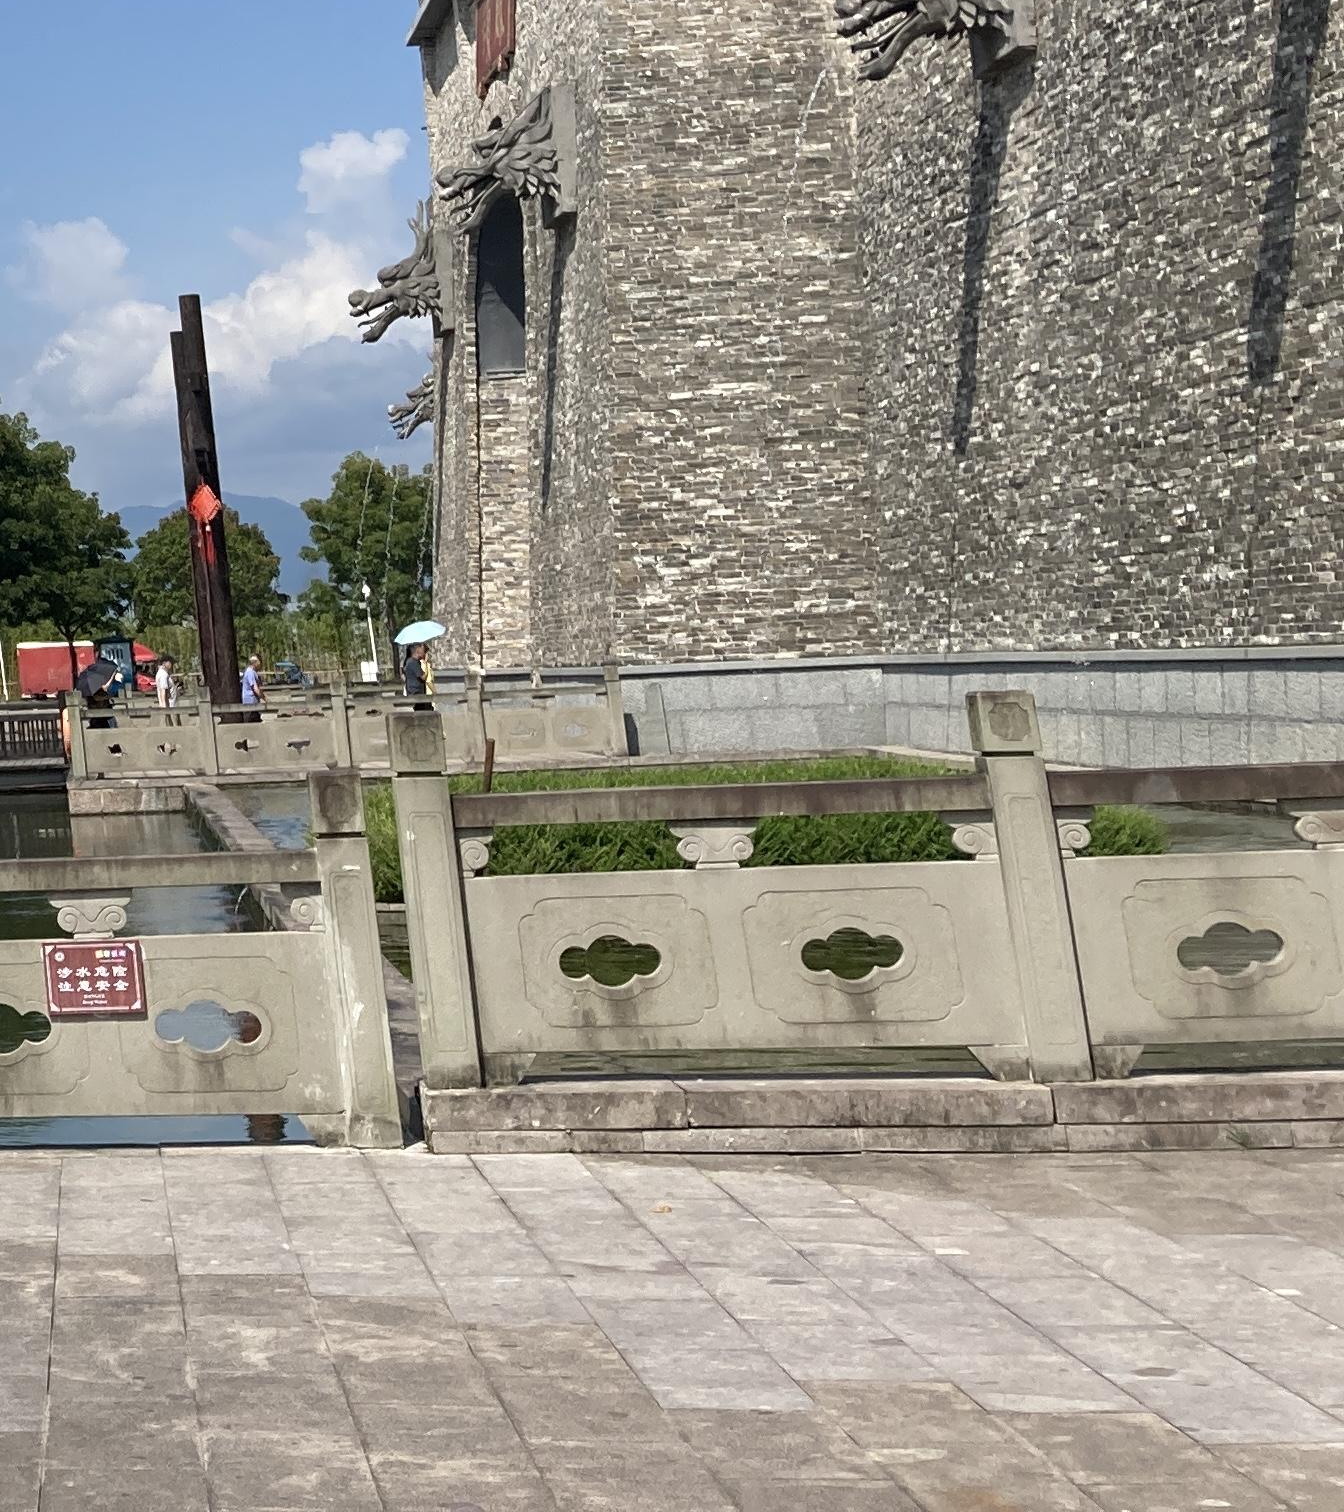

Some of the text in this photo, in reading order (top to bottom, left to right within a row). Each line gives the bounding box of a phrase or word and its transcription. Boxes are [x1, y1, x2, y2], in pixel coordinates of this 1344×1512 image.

[56, 965, 128, 978] 涉水危险
[57, 979, 130, 992] 注意安全
